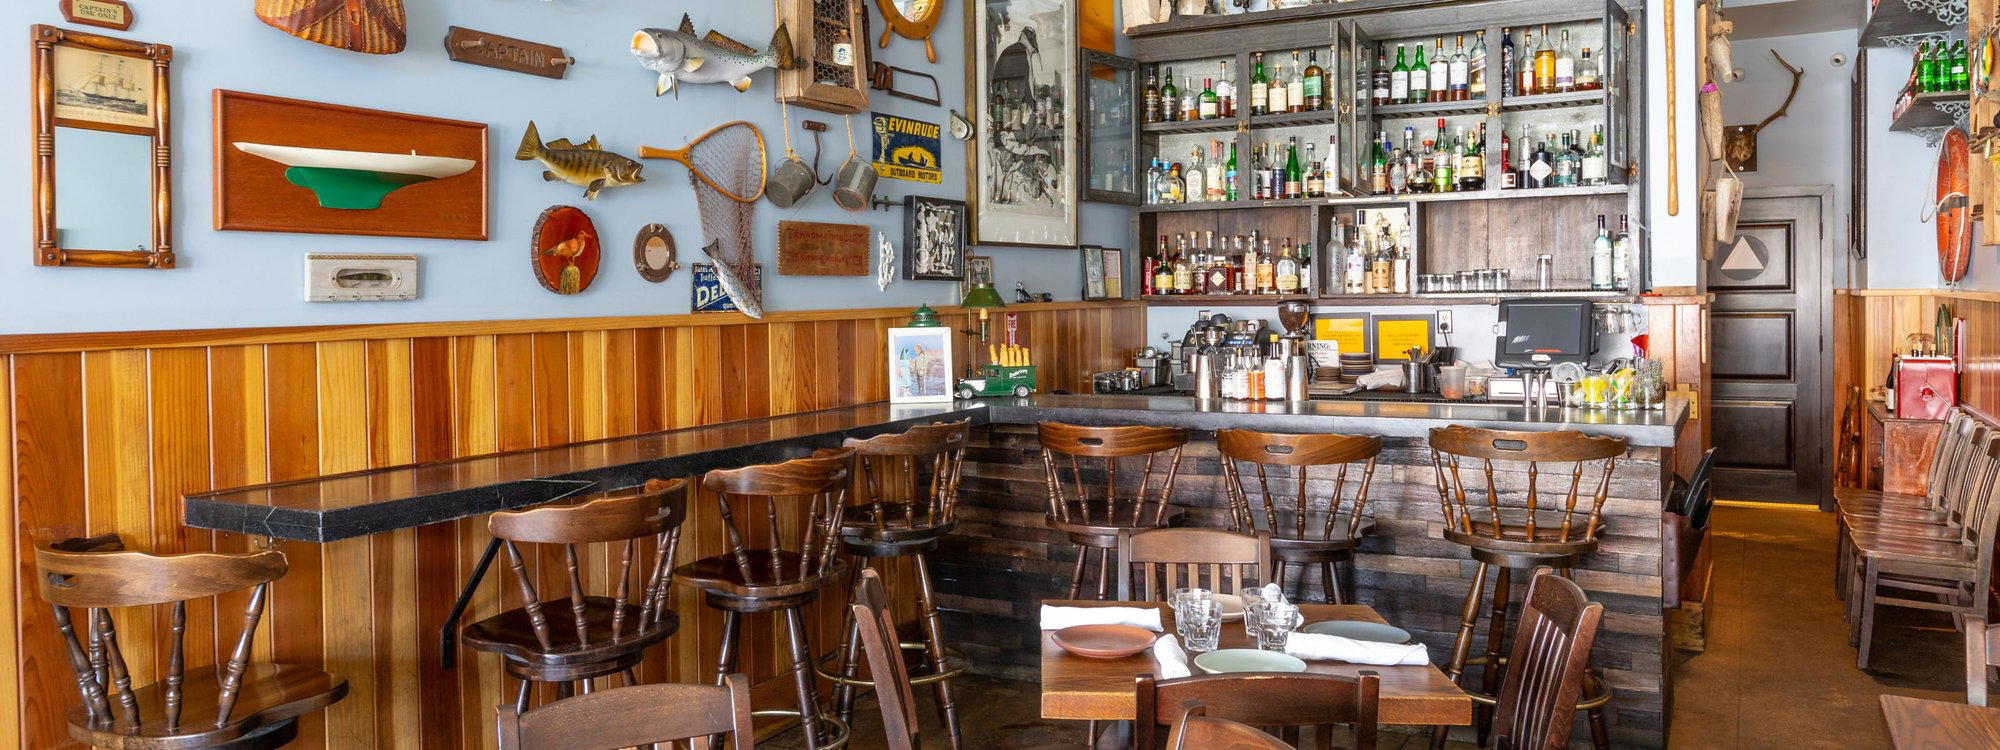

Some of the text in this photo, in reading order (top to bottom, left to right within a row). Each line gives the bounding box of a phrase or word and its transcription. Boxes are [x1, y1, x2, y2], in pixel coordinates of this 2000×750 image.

[79, 4, 118, 15] CAPTAIN'S
[97, 12, 118, 20] ONLY
[888, 117, 940, 139] EVINRUDE
[890, 167, 938, 181] OUTBOARD MOTORS
